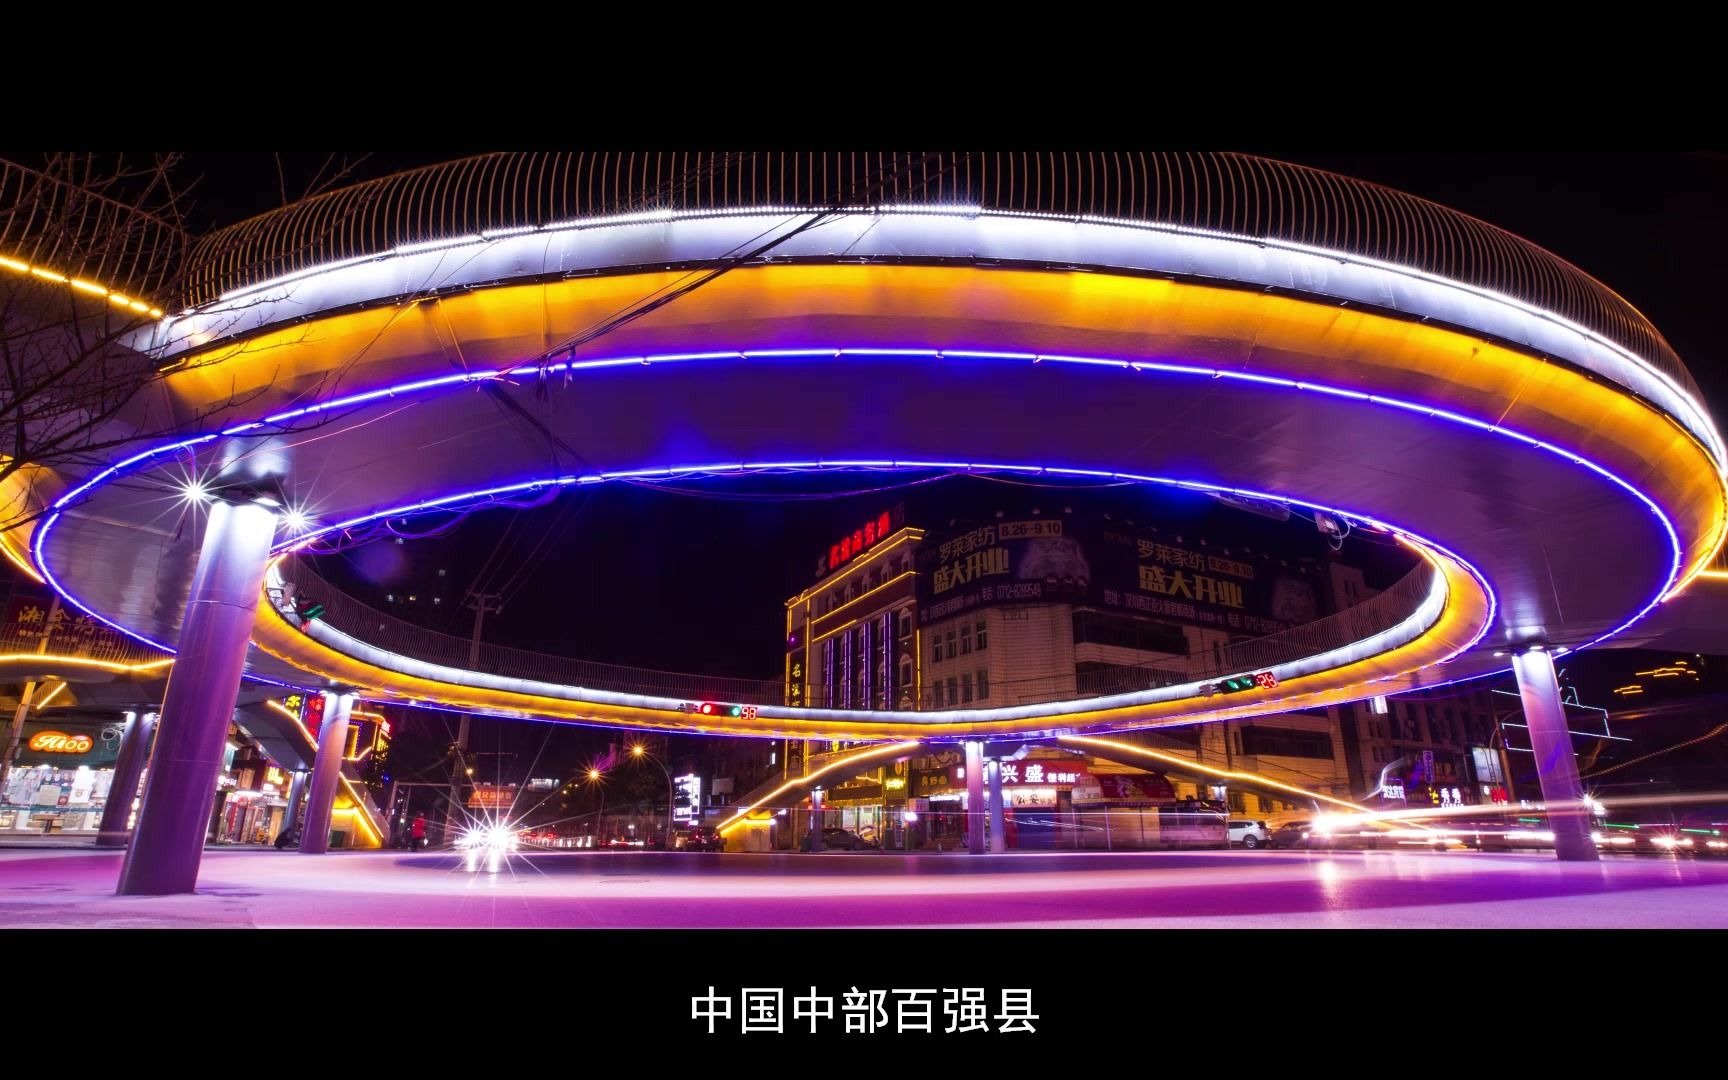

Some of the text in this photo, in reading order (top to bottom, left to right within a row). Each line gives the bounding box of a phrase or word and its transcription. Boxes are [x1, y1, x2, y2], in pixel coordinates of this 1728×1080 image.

[938, 525, 997, 565] 罗莱家纺
[1136, 538, 1206, 573] 罗莱家纺
[933, 547, 1010, 595] 盛大开业
[1137, 564, 1245, 609] 盛大开业
[741, 707, 757, 720] 98
